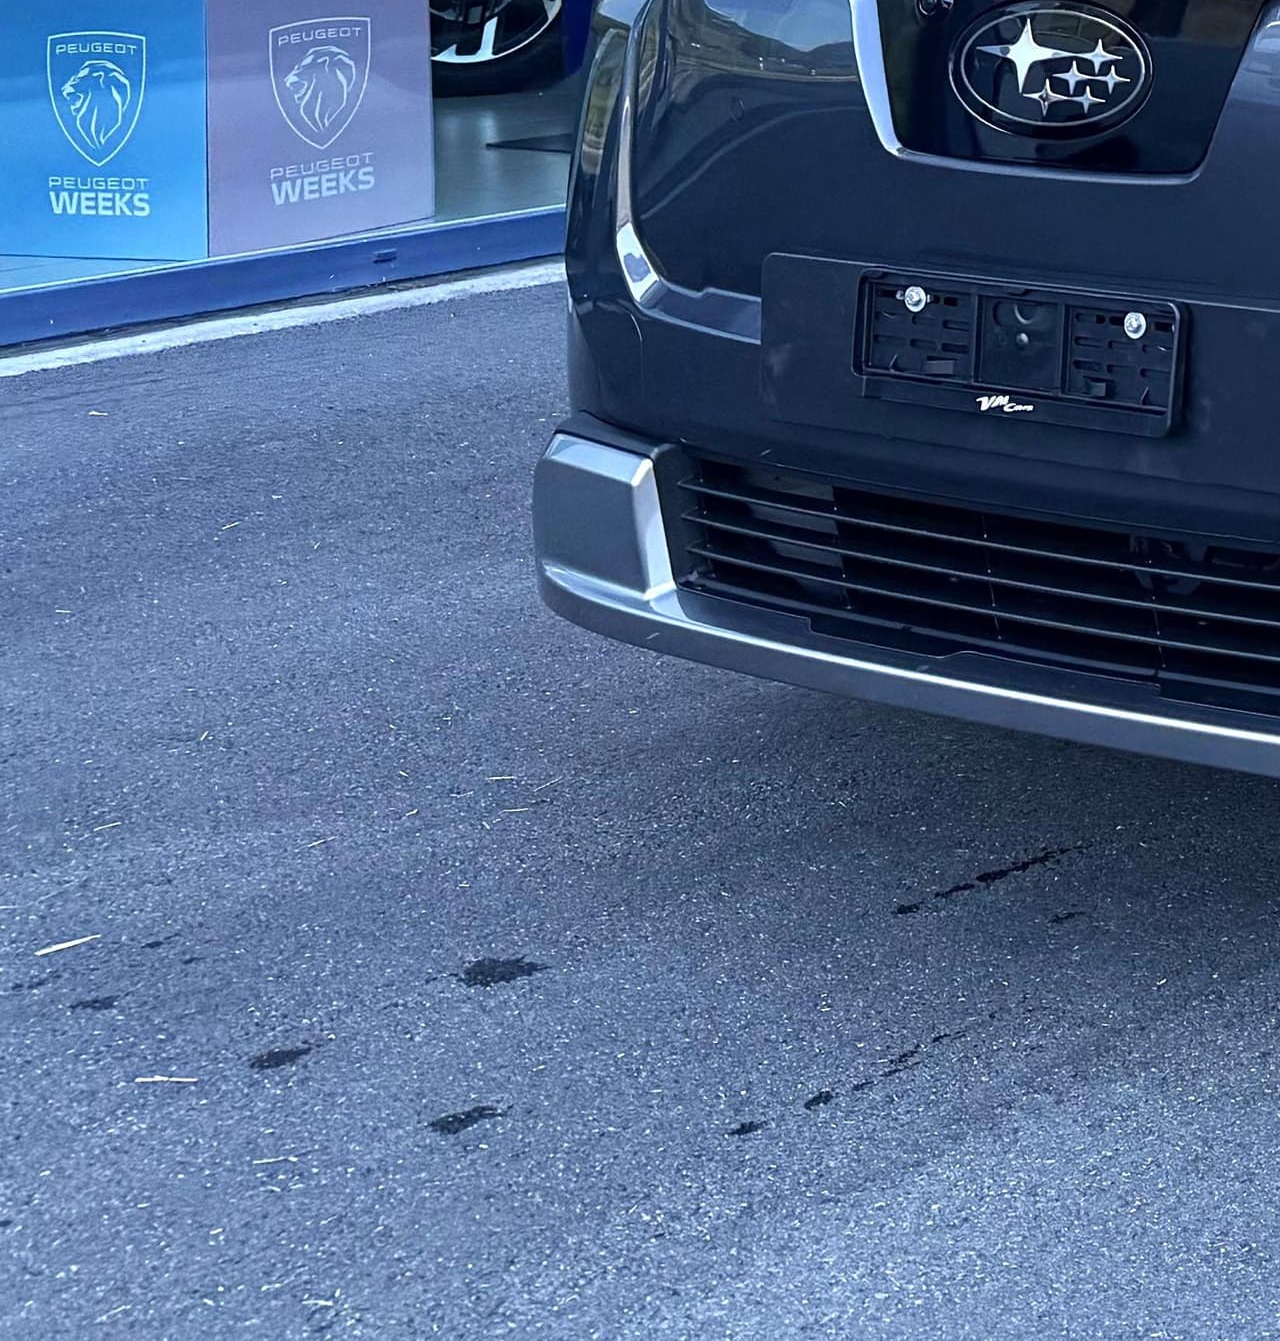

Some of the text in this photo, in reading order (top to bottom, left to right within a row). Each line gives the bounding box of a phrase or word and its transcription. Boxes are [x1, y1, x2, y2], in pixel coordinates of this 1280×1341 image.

[278, 27, 361, 47] PEUGEOT
[55, 43, 138, 56] PEUGEOT
[270, 152, 375, 180] PEUGEOT
[48, 176, 149, 191] PEUGEOT
[271, 166, 376, 206] WEEKS
[49, 191, 151, 217] WEEKS
